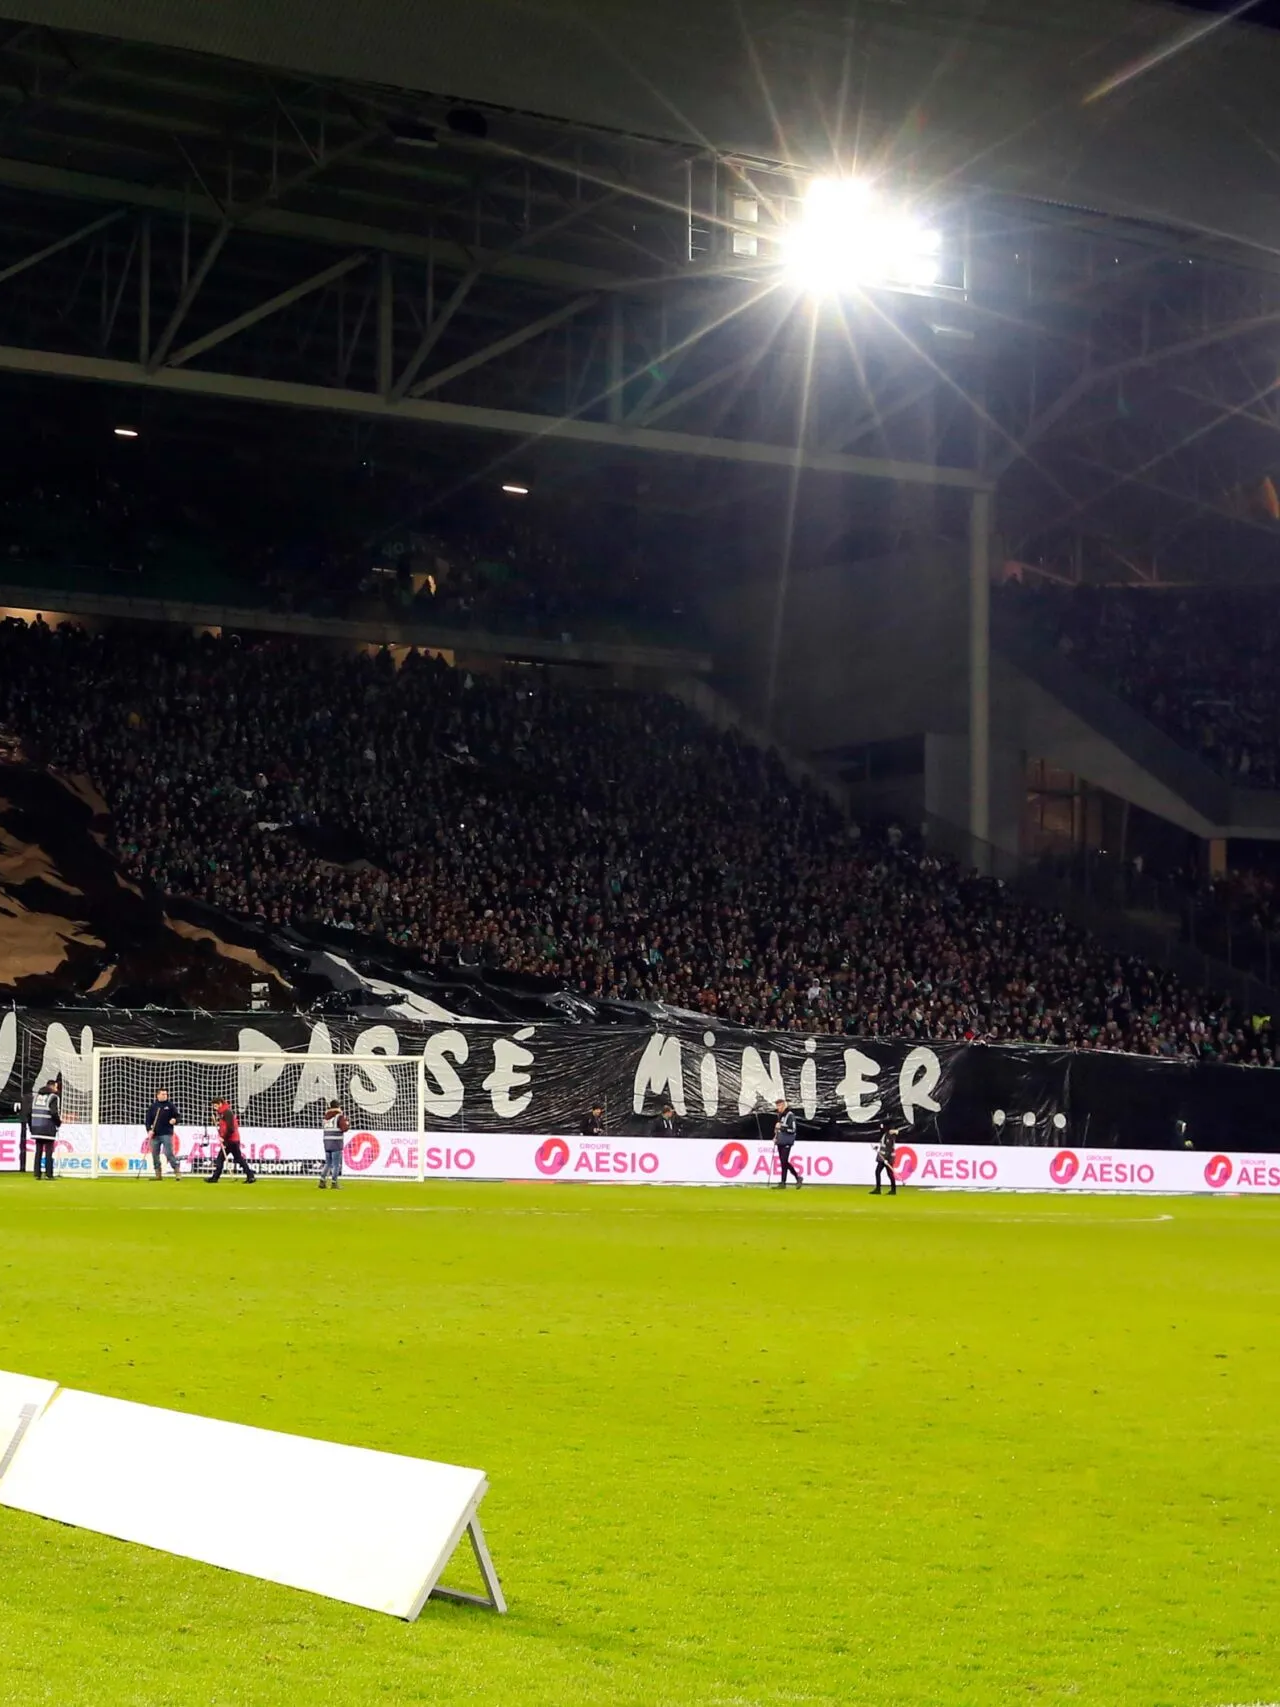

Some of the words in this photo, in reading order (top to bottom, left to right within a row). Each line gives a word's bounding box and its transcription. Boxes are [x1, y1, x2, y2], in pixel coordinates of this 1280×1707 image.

[238, 1021, 535, 1118] PASSÉ
[384, 1146, 476, 1170] AESIO
[574, 1151, 660, 1174] AESIO
[921, 1159, 998, 1180] AESIO
[1081, 1163, 1155, 1184] AESIO
